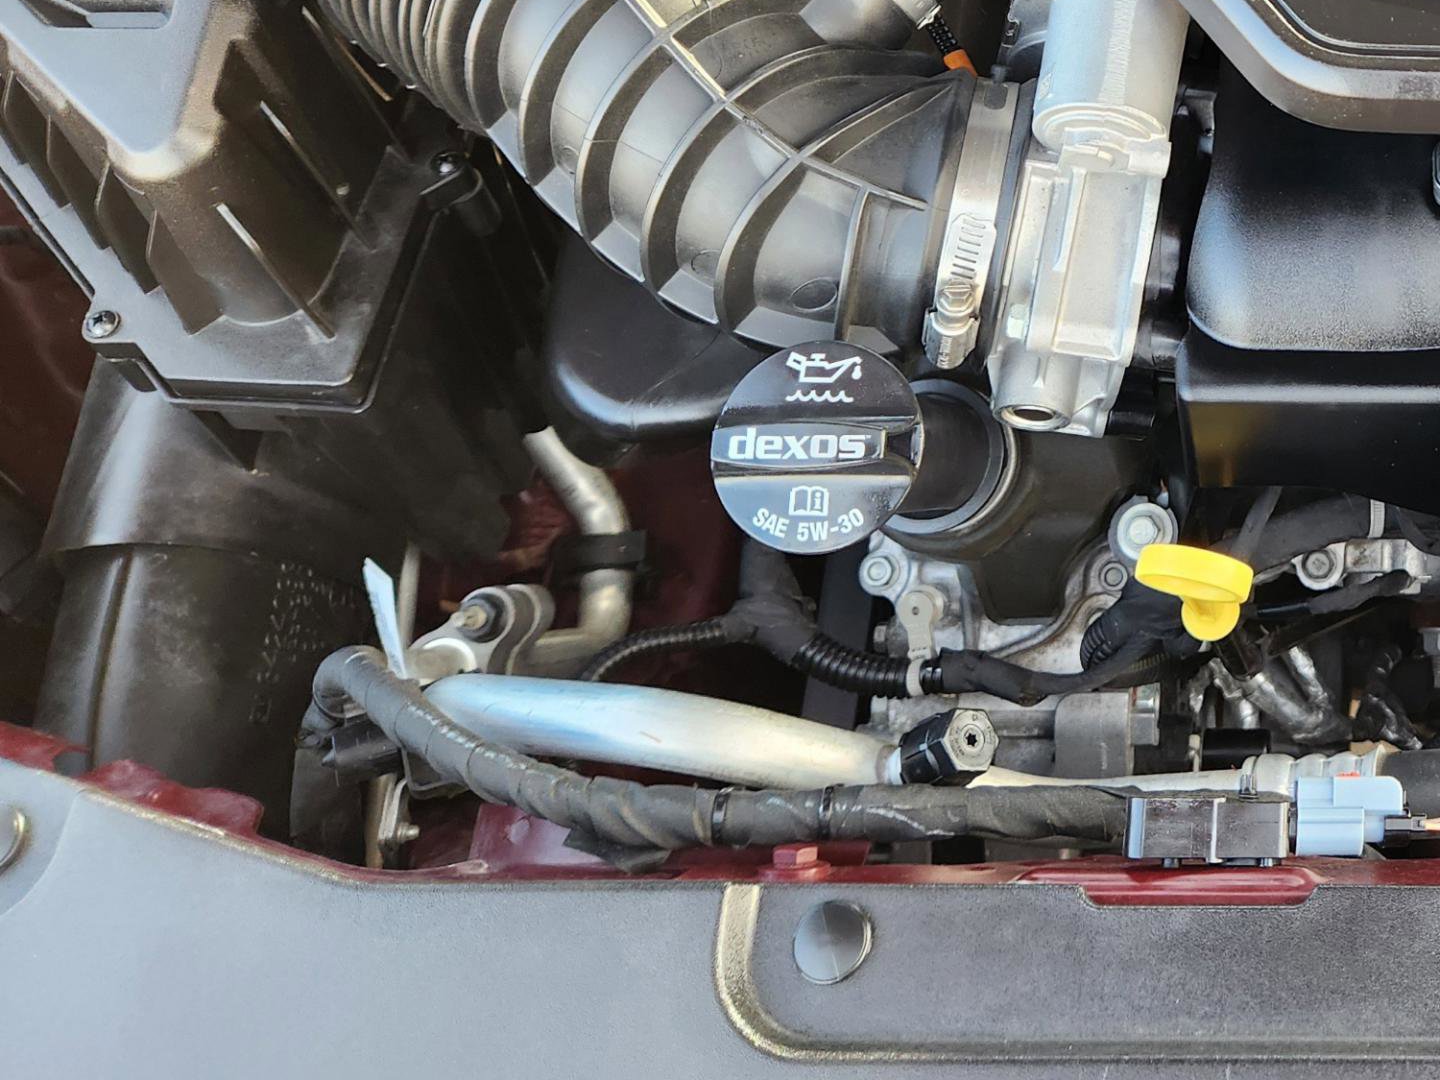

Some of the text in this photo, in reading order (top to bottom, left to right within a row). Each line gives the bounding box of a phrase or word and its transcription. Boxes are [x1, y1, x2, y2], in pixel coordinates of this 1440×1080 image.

[728, 427, 867, 460] dexos
[752, 508, 864, 542] SAE 5W-30
